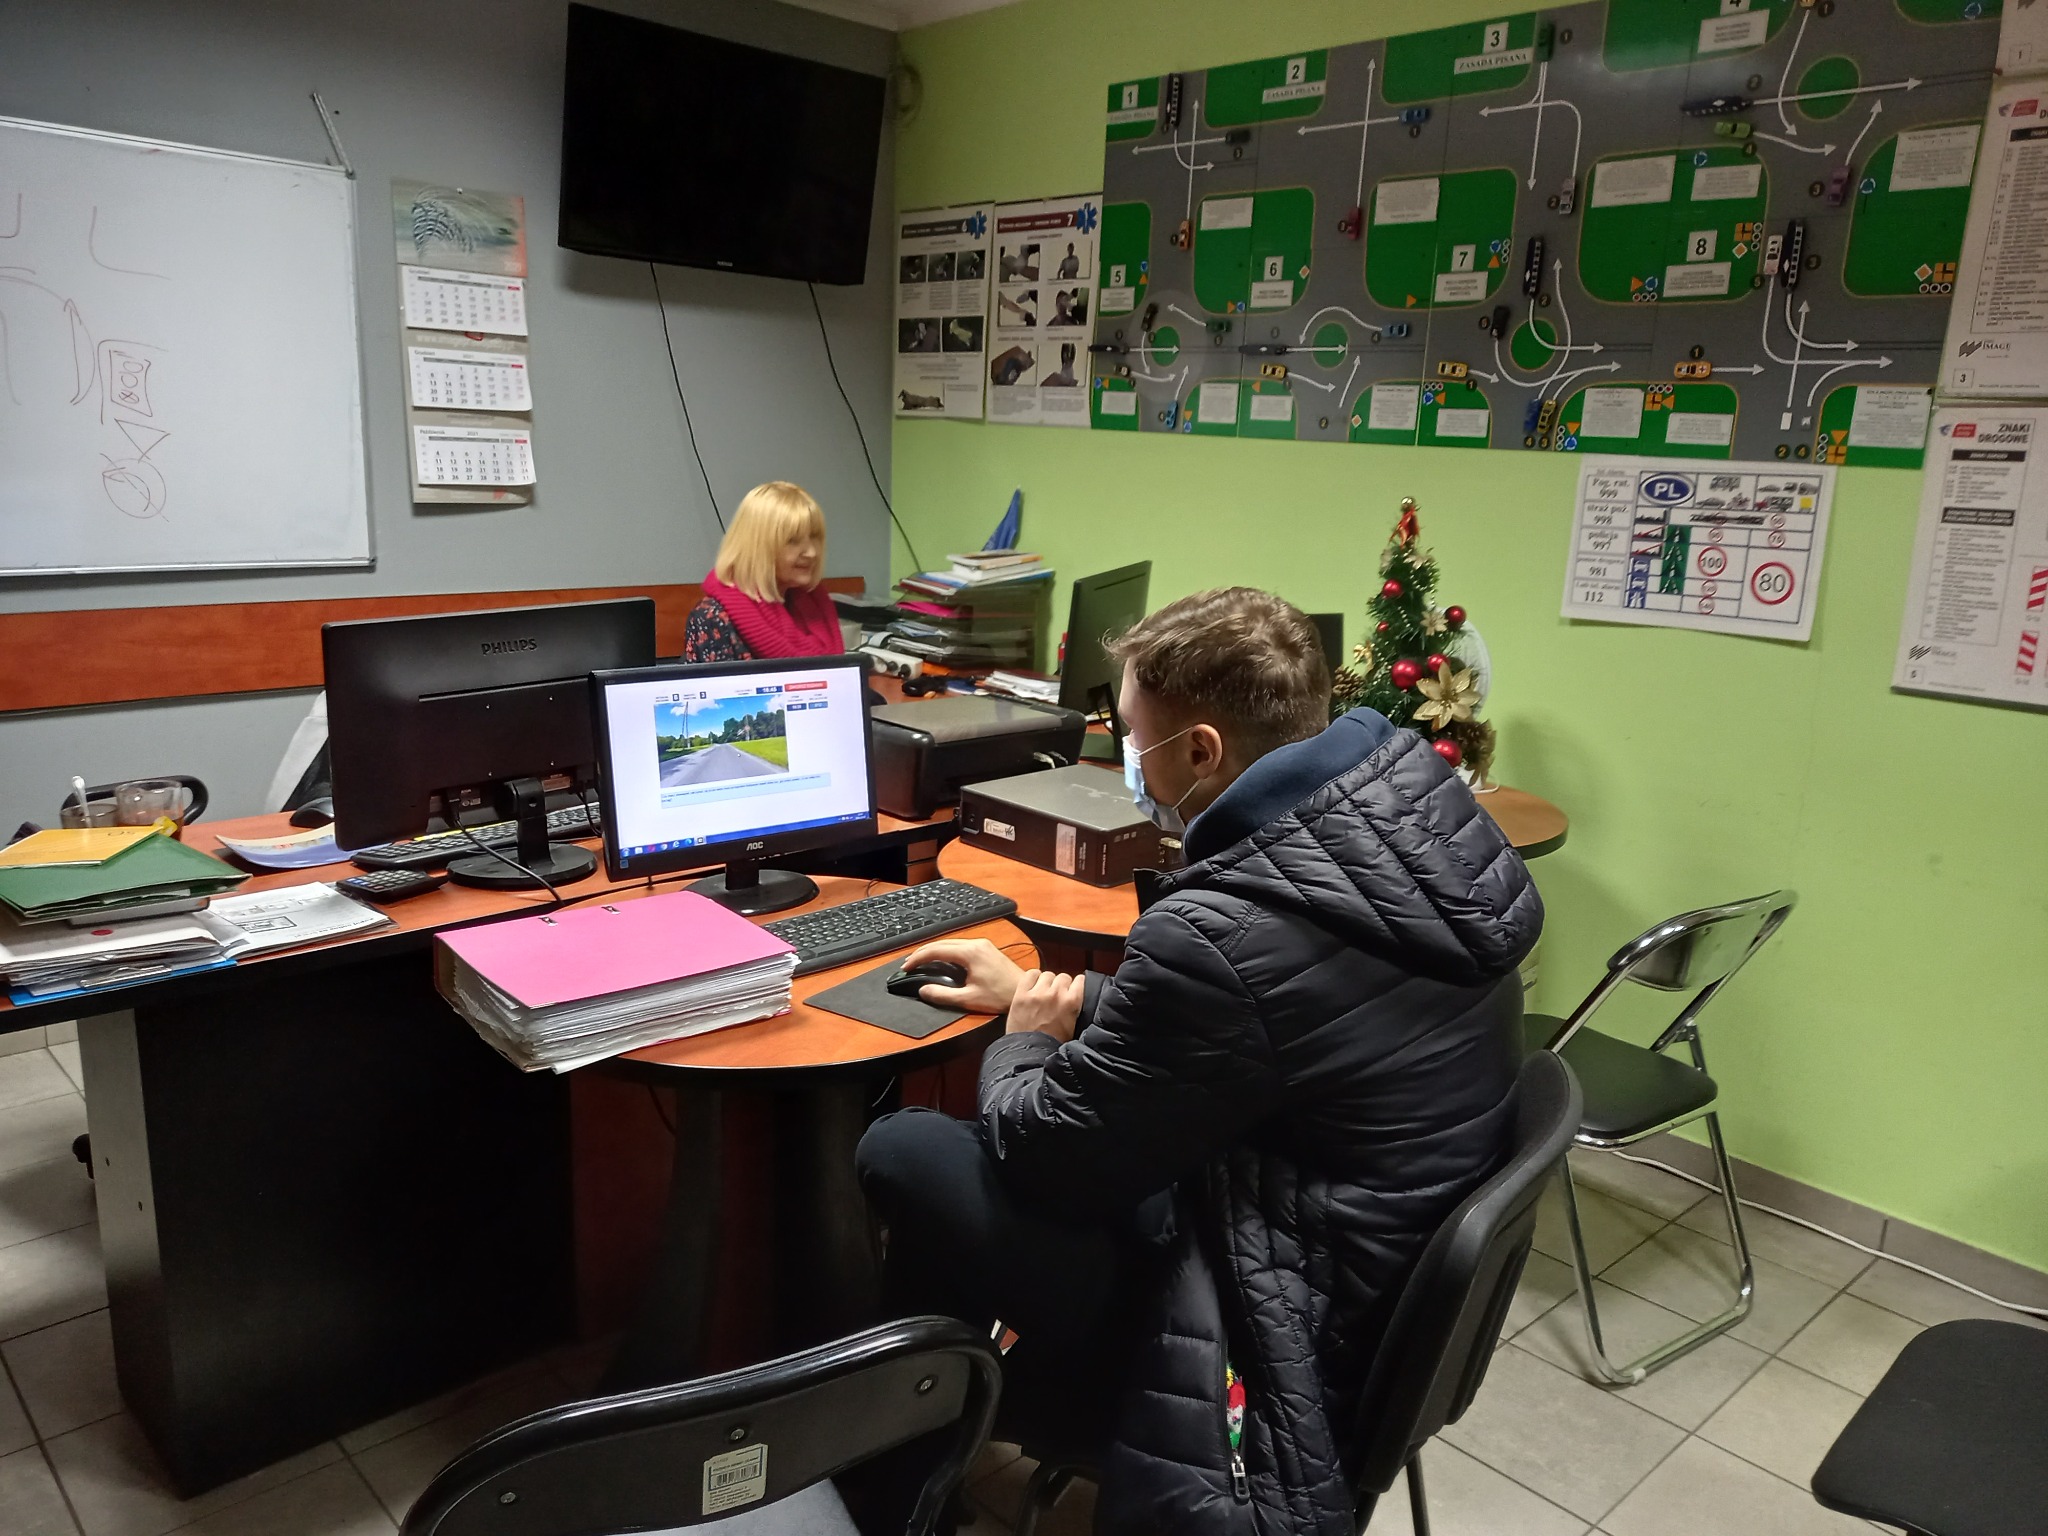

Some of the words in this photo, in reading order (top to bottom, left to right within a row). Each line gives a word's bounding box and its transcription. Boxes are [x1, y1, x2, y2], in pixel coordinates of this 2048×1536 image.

[1490, 31, 1500, 47] 3
[1459, 60, 1492, 69] ZASADA
[1495, 54, 1526, 64] PISANA
[1292, 65, 1300, 79] 2
[1128, 91, 1133, 104] 1
[1067, 214, 1073, 227] 7
[1695, 238, 1707, 256] 8
[1460, 252, 1468, 267] 7
[1270, 262, 1277, 276] 6
[1115, 270, 1121, 283] 5
[1694, 348, 1699, 357] 1
[1960, 373, 1966, 382] 3
[1998, 423, 2031, 433] ZNAKI
[1526, 437, 1532, 446] 4
[1978, 434, 2028, 443] DROGOWE
[1779, 447, 1786, 457] 2
[1798, 447, 1805, 456] 4
[1600, 489, 1618, 498] 999
[1653, 482, 1681, 498] PL
[1594, 515, 1612, 525] 998
[1588, 531, 1618, 540] policja
[1593, 541, 1611, 550] 997
[1700, 557, 1722, 569] 100
[1589, 566, 1607, 577] 981
[1759, 573, 1786, 593] 80
[1584, 591, 1604, 602] 112
[481, 638, 538, 656] PHILIPS
[746, 841, 763, 851] AOC
